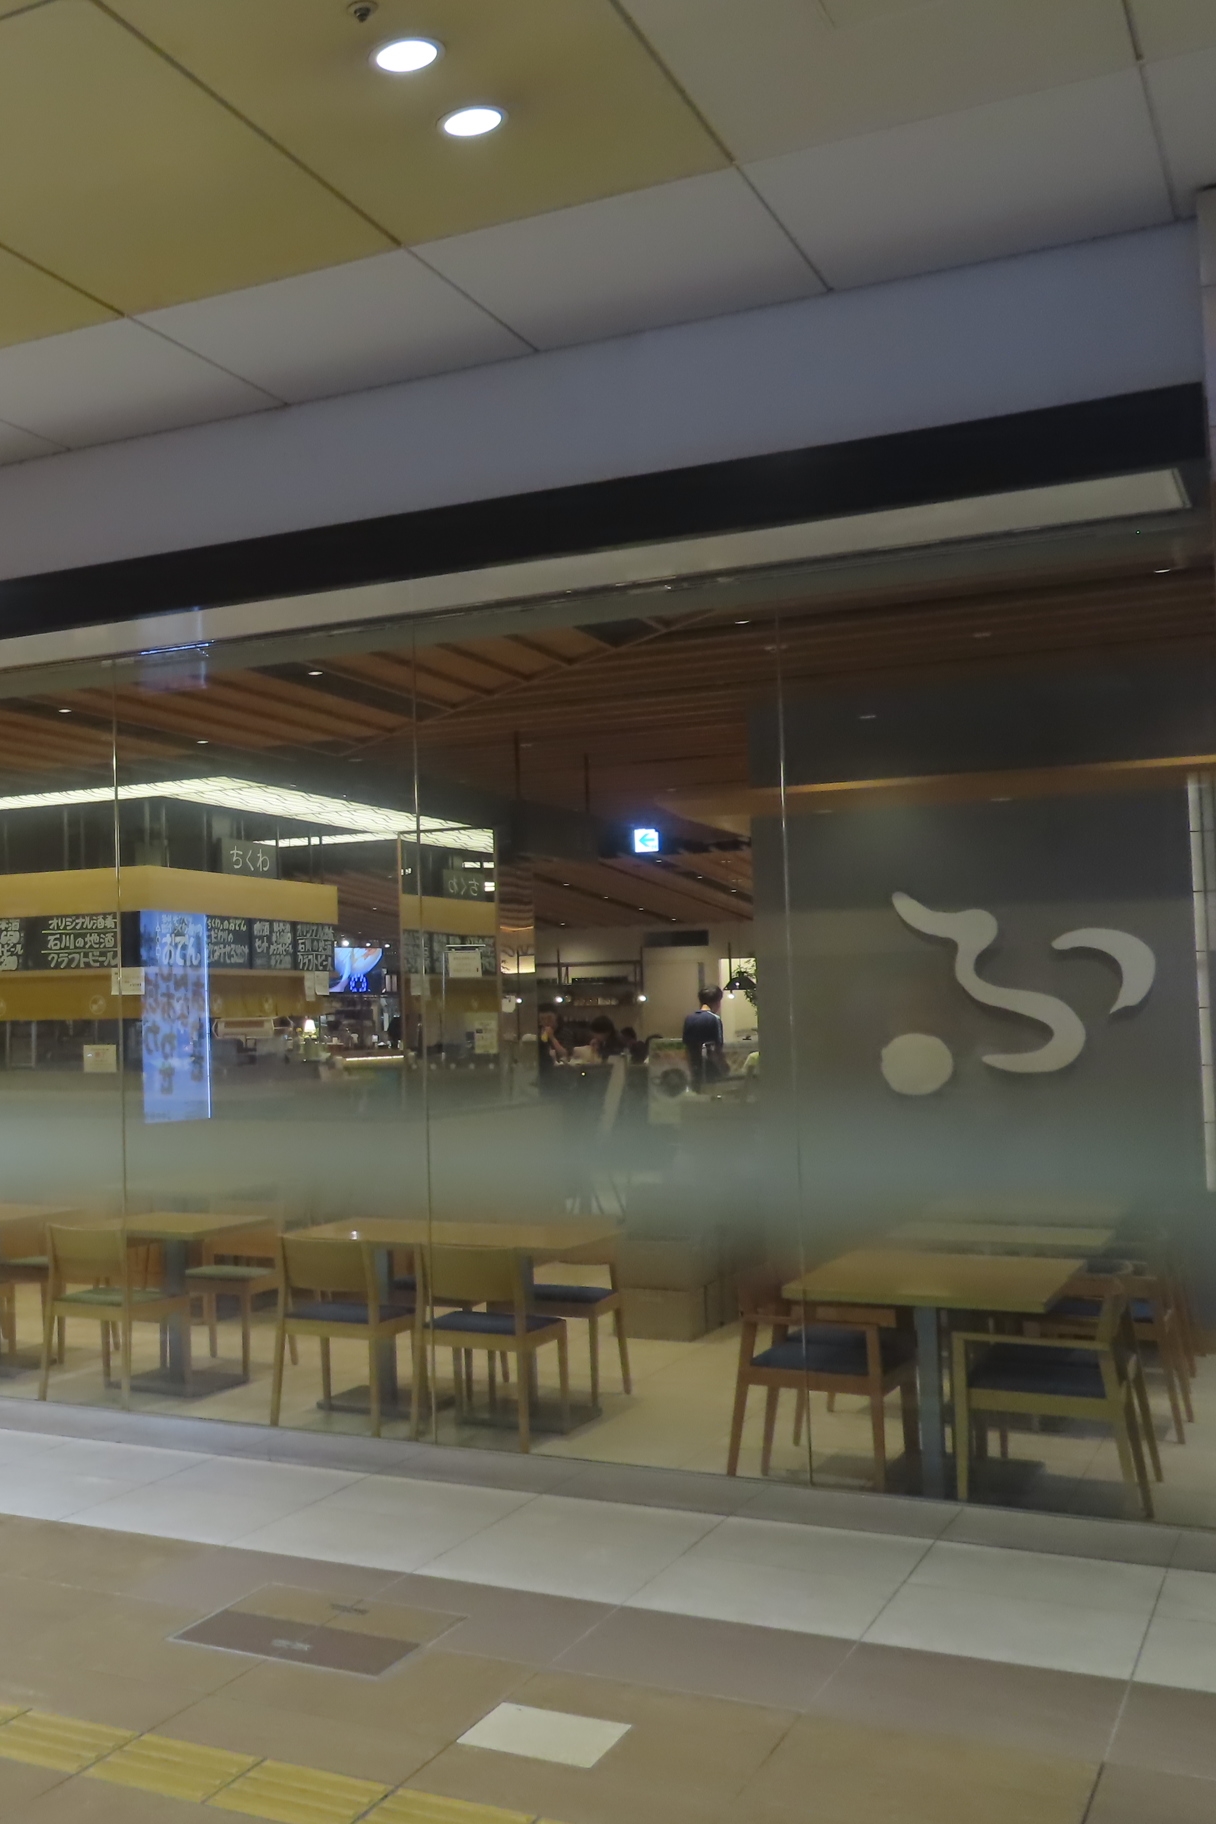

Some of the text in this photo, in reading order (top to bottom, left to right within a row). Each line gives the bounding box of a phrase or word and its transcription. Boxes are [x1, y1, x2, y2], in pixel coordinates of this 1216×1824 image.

[230, 845, 270, 872] ちくわ
[47, 932, 115, 949] 石川の地酒
[162, 934, 201, 966] おでん
[48, 951, 119, 969] クラフトビール
